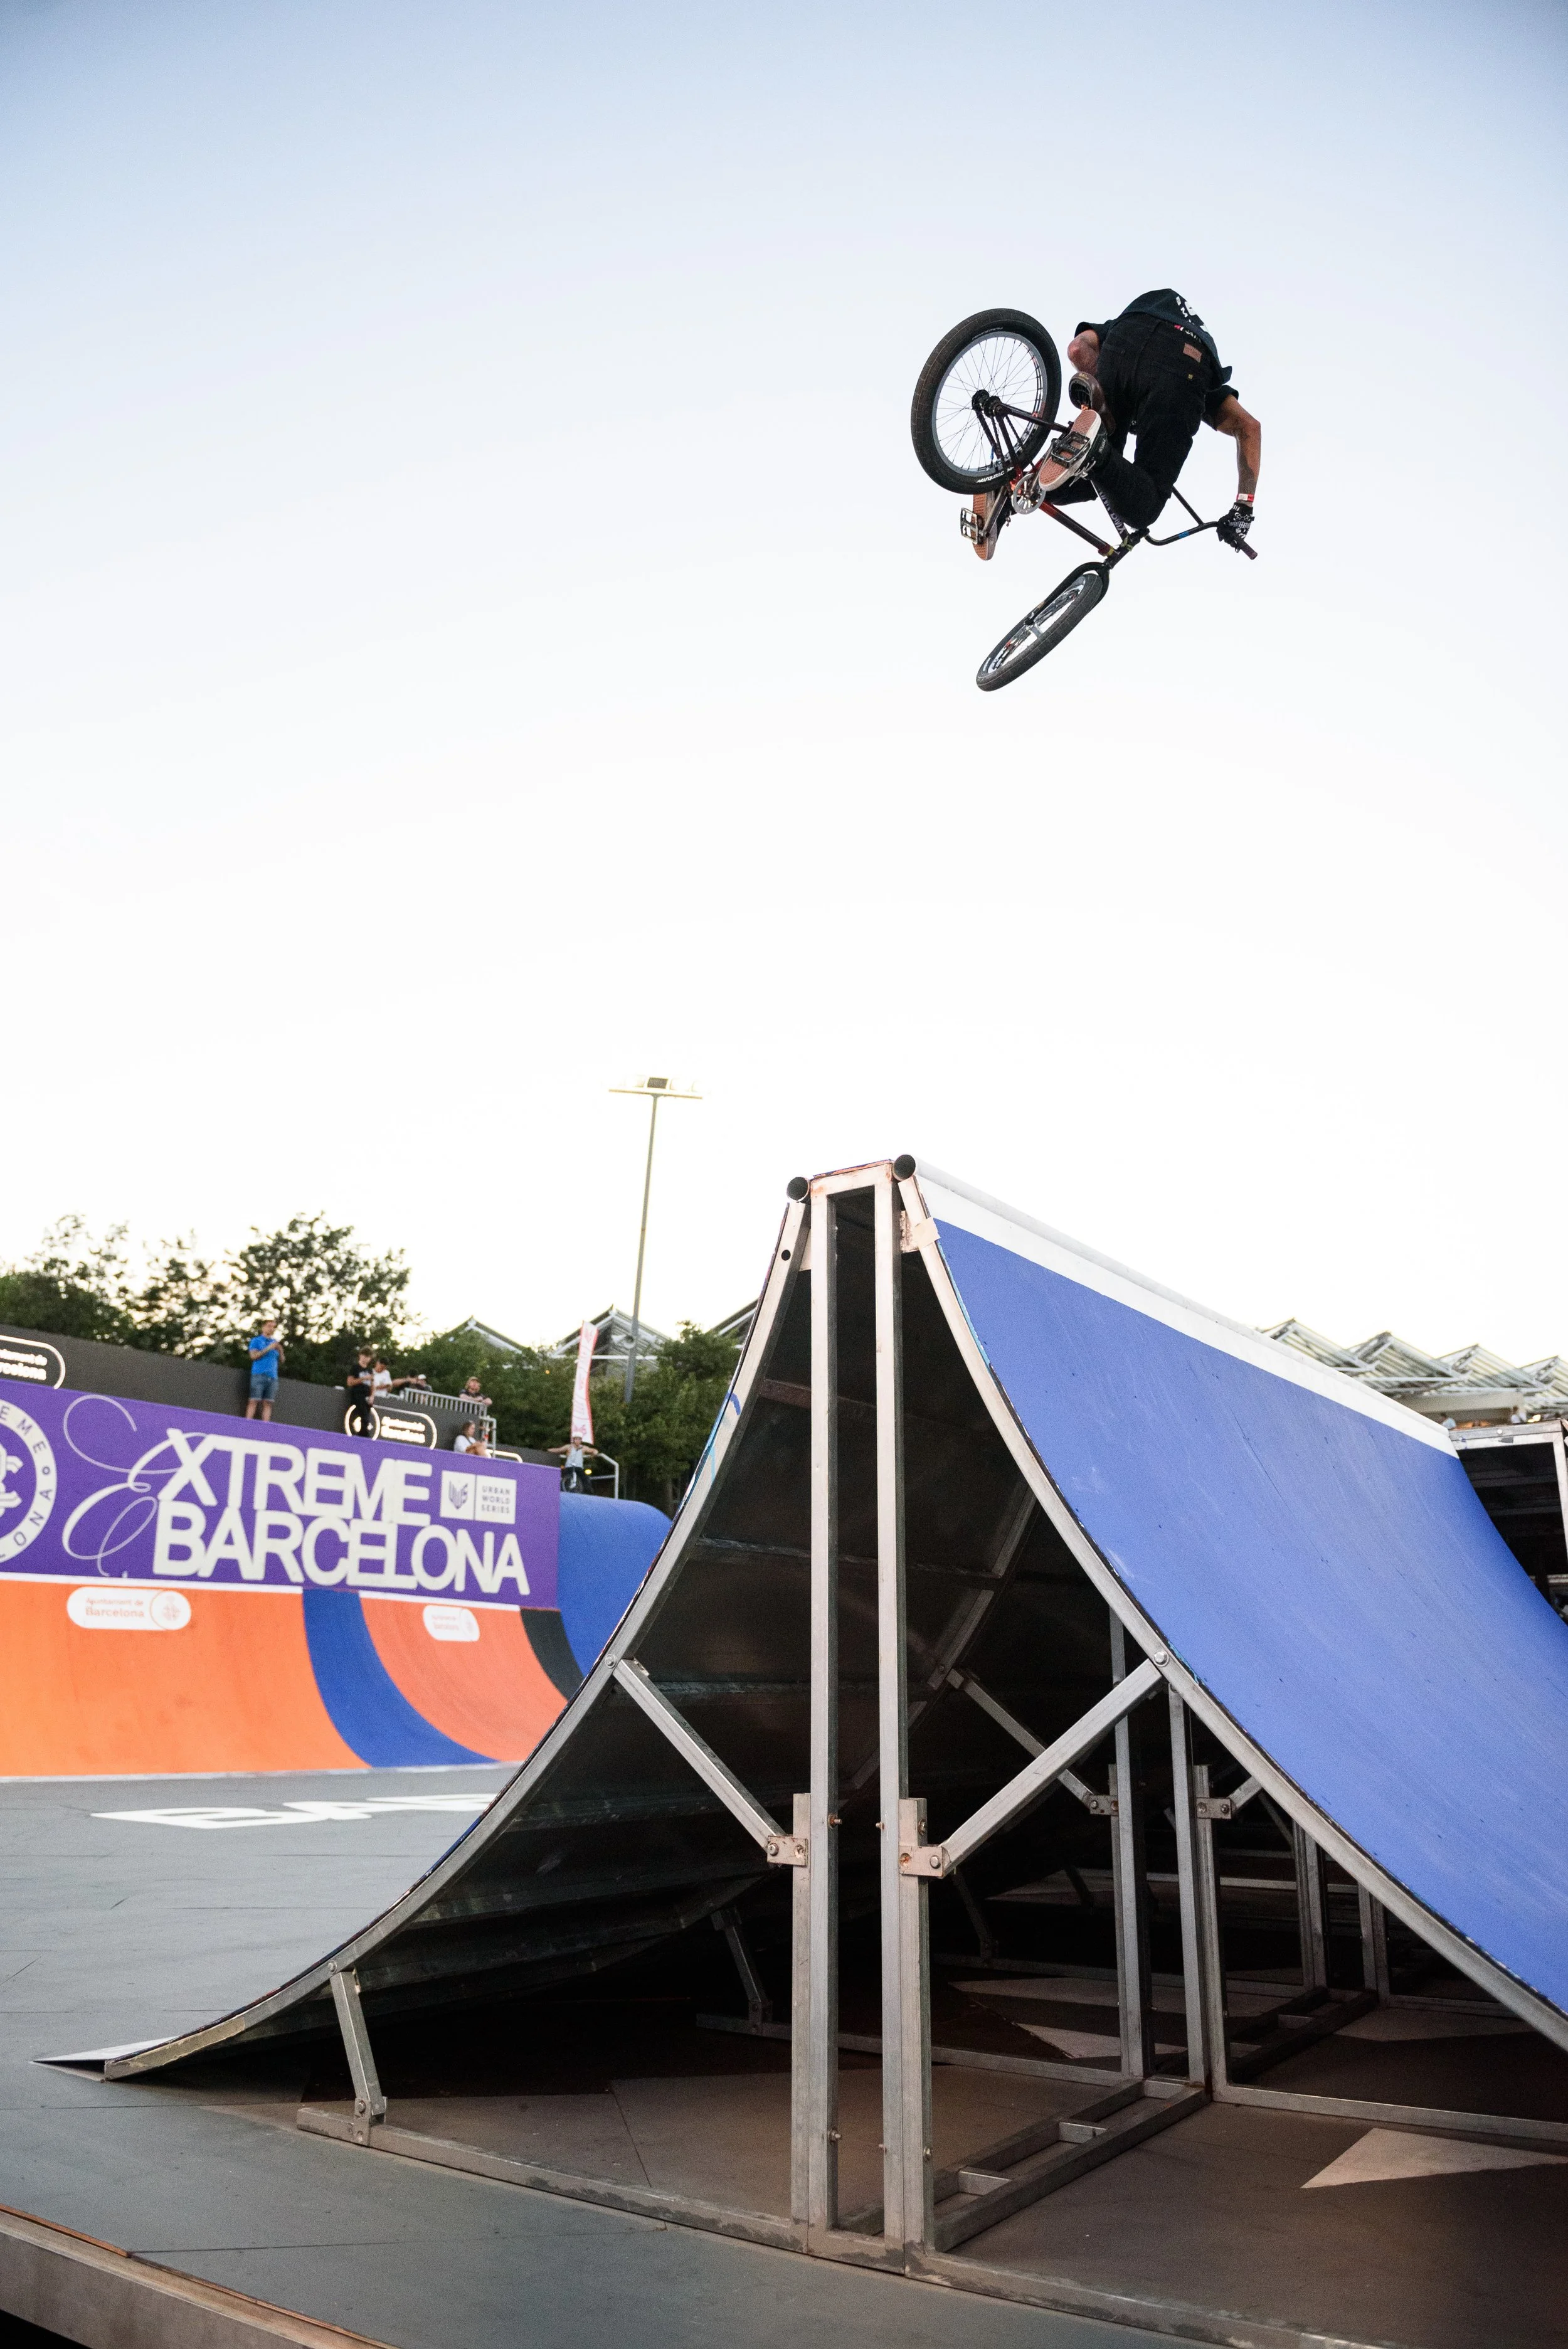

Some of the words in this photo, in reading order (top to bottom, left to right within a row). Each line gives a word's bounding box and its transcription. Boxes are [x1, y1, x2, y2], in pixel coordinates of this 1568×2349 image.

[482, 1485, 511, 1496] URBAN
[482, 1495, 511, 1505] WORLD
[481, 1504, 510, 1514] SERIES
[153, 1499, 531, 1596] BARCELONA
[85, 1606, 145, 1618] Barcelona
